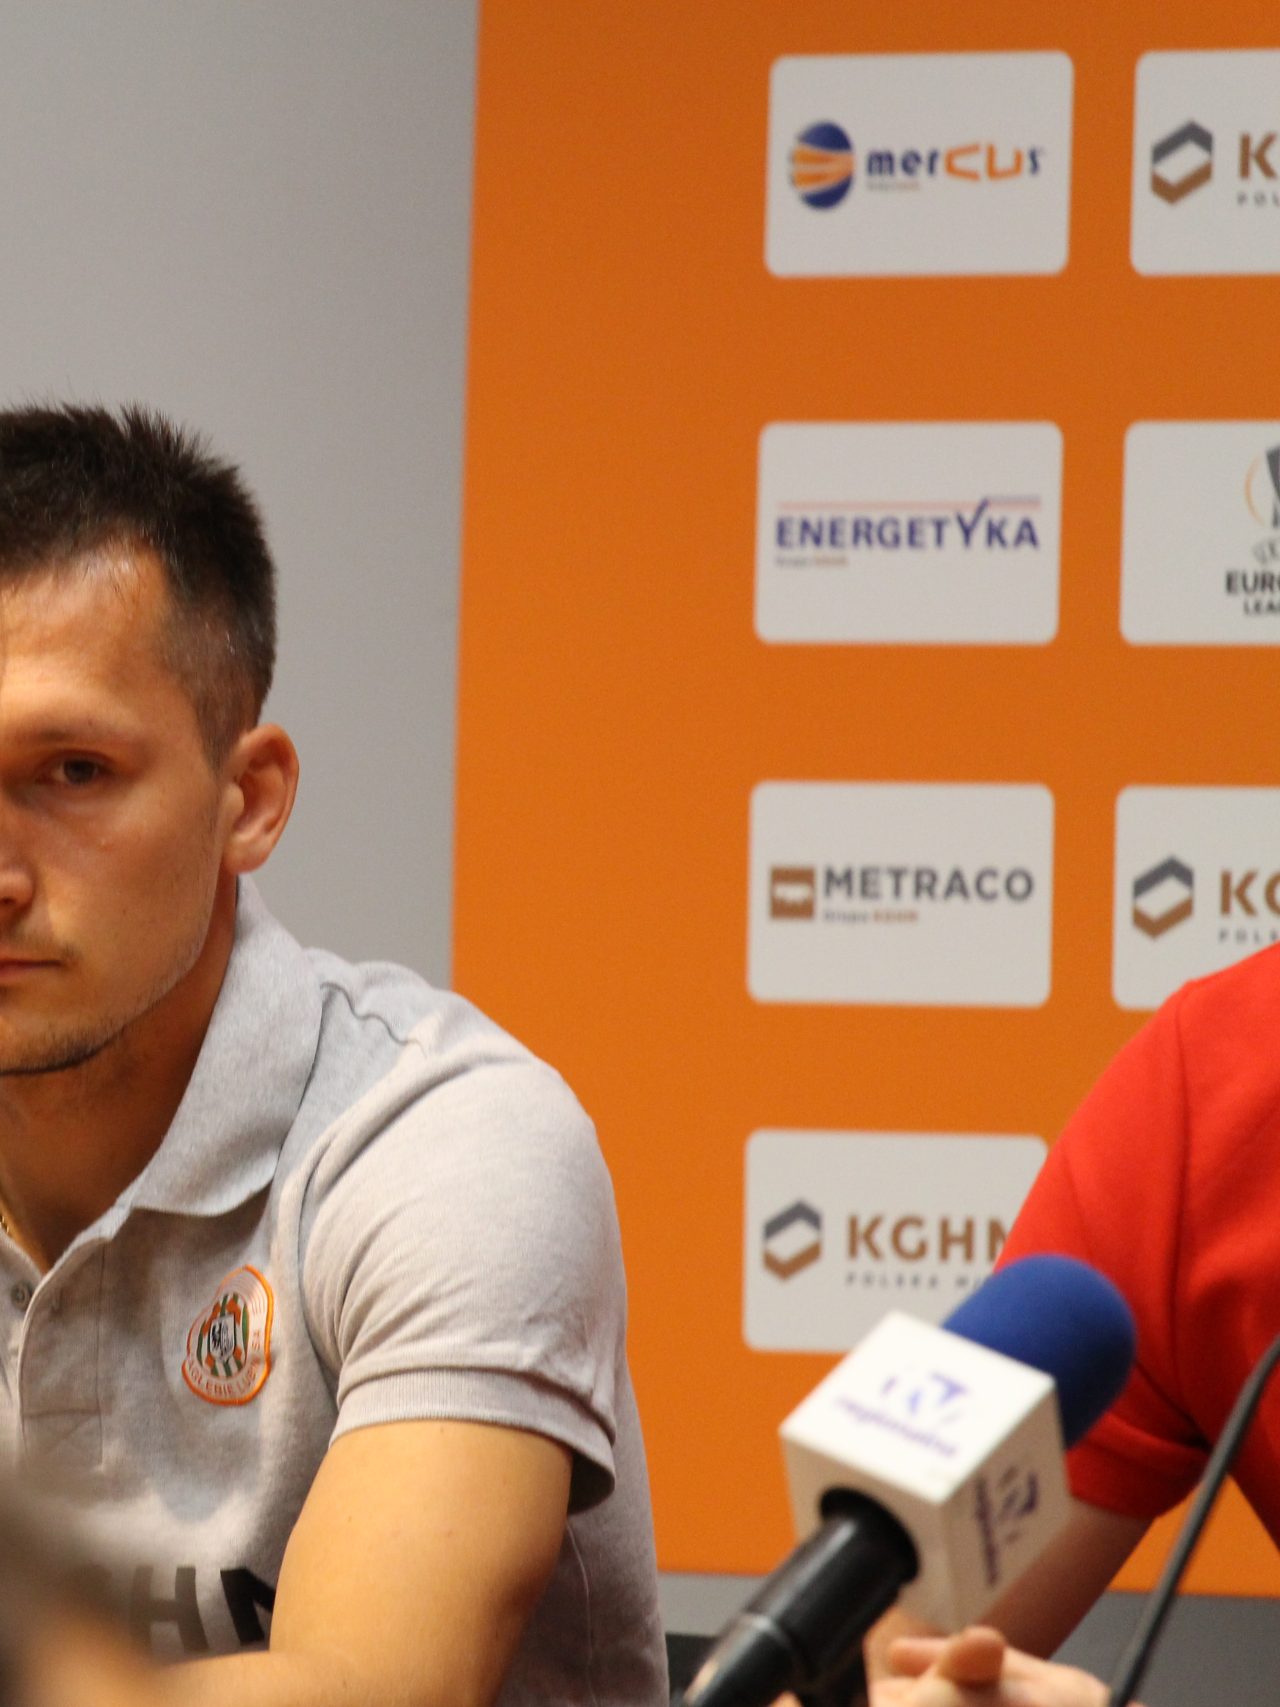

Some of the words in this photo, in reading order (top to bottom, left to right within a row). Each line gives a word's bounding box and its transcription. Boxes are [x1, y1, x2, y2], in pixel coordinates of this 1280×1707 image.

[776, 497, 1040, 549] ENERGETYKA
[1225, 570, 1280, 595] EUR
[823, 867, 1035, 902] METRACO
